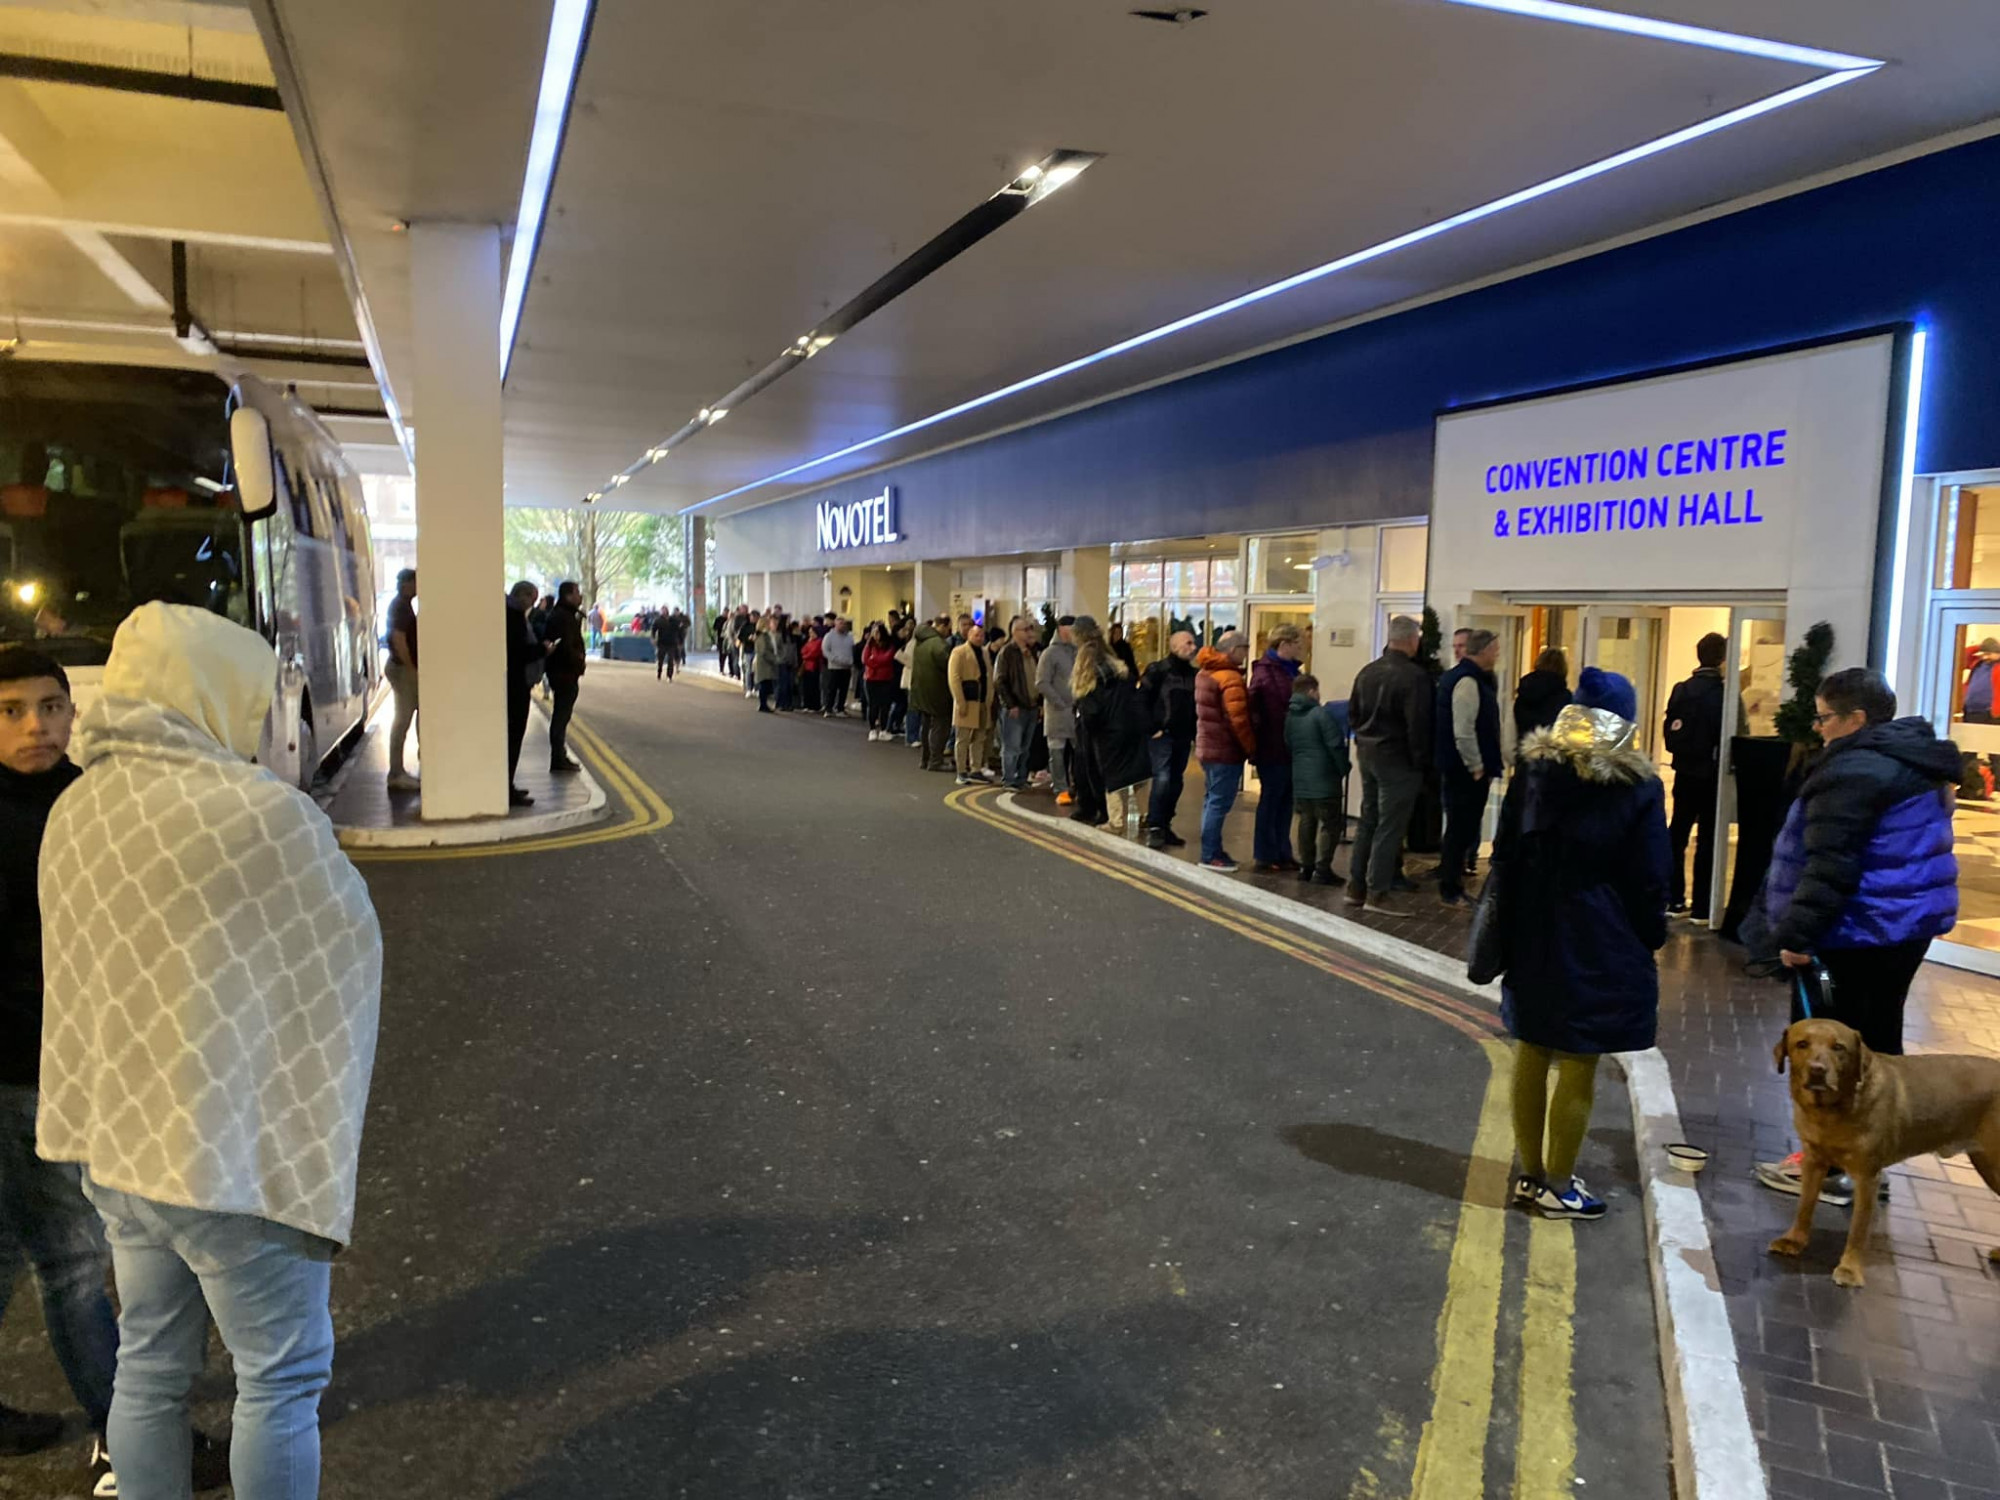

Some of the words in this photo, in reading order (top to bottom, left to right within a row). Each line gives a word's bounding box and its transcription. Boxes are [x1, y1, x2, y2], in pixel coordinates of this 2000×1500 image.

[1485, 446, 1649, 494] CONVENTION
[1656, 429, 1788, 477] CENTRE
[816, 486, 898, 551] NOVOTEL
[1494, 509, 1510, 537] &
[1517, 496, 1669, 537] EXHIBITION
[1678, 489, 1763, 528] HALL
